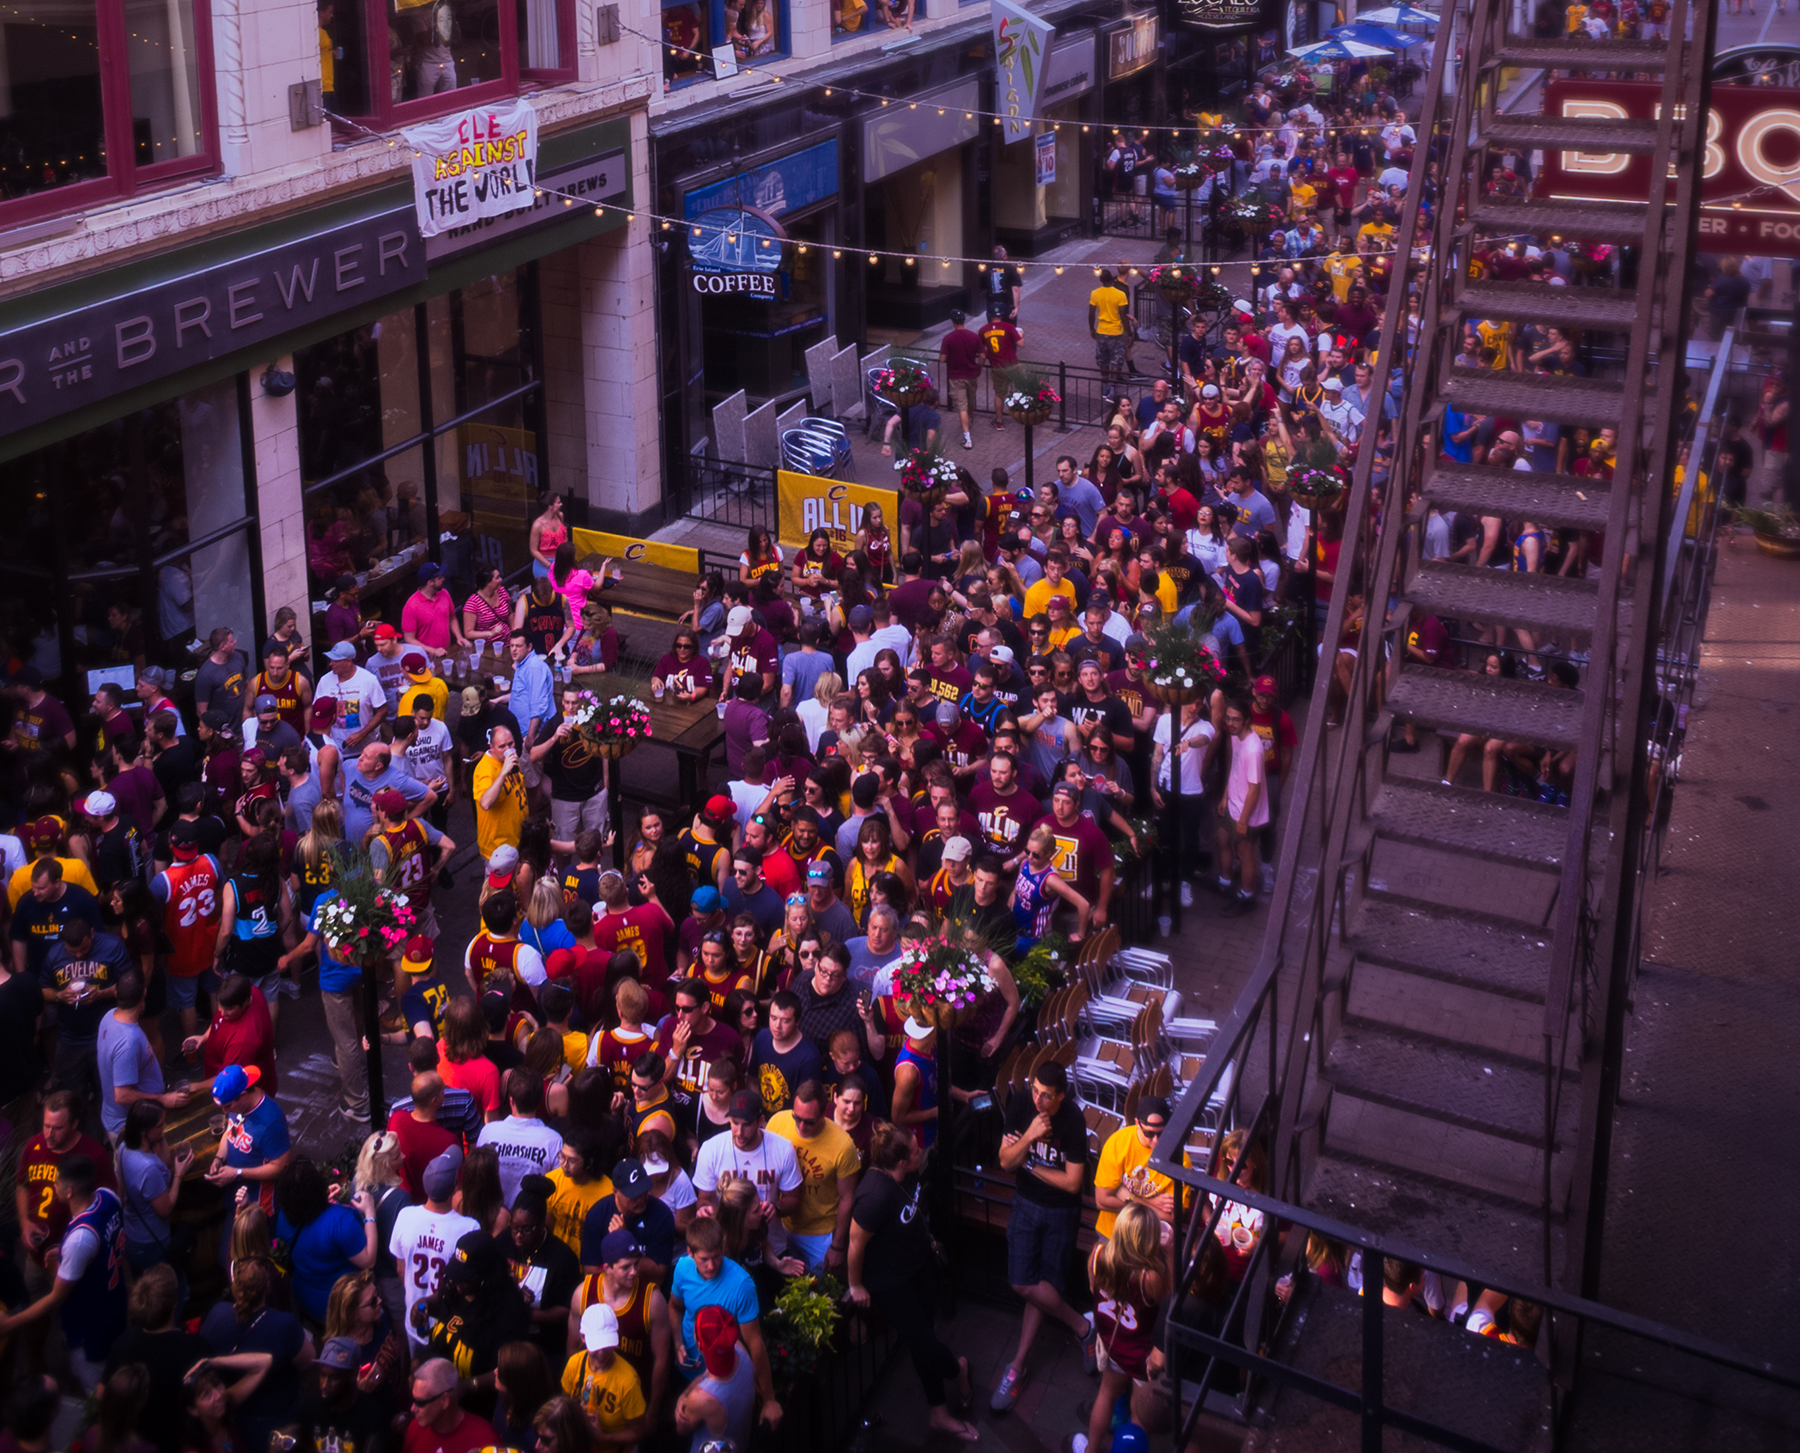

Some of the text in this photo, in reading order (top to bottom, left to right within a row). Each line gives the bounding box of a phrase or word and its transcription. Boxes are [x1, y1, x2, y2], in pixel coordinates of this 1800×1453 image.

[458, 114, 502, 145] CLE
[434, 129, 528, 182] AGAINST
[425, 180, 470, 221] THE
[556, 173, 608, 203] BREWS
[693, 274, 776, 294] COFFEE
[749, 292, 774, 301] Company
[115, 230, 410, 370] BREWER
[48, 336, 91, 363] AND
[990, 336, 1000, 353] 8
[52, 366, 93, 390] THE
[803, 497, 847, 535] ALL
[530, 615, 563, 631] CAVS
[544, 633, 555, 652] 8
[1071, 706, 1106, 726] WT
[408, 744, 440, 757] AGAINST
[978, 811, 1021, 843] ALL IN
[400, 852, 424, 888] 23
[179, 873, 211, 897] JAMES
[178, 888, 216, 928] 23
[251, 904, 272, 936] 2
[616, 925, 640, 943] JAMES
[55, 960, 109, 987] CLEVELAND
[480, 956, 497, 971] LOVE
[676, 1057, 697, 1083] LL
[490, 1141, 547, 1167] THRASHER
[629, 1169, 639, 1184] C
[757, 1169, 776, 1185] IN
[38, 1186, 54, 1219] 2
[417, 1234, 445, 1254] JAMES
[413, 1253, 446, 1294] 23
[1097, 1299, 1138, 1331] 23
